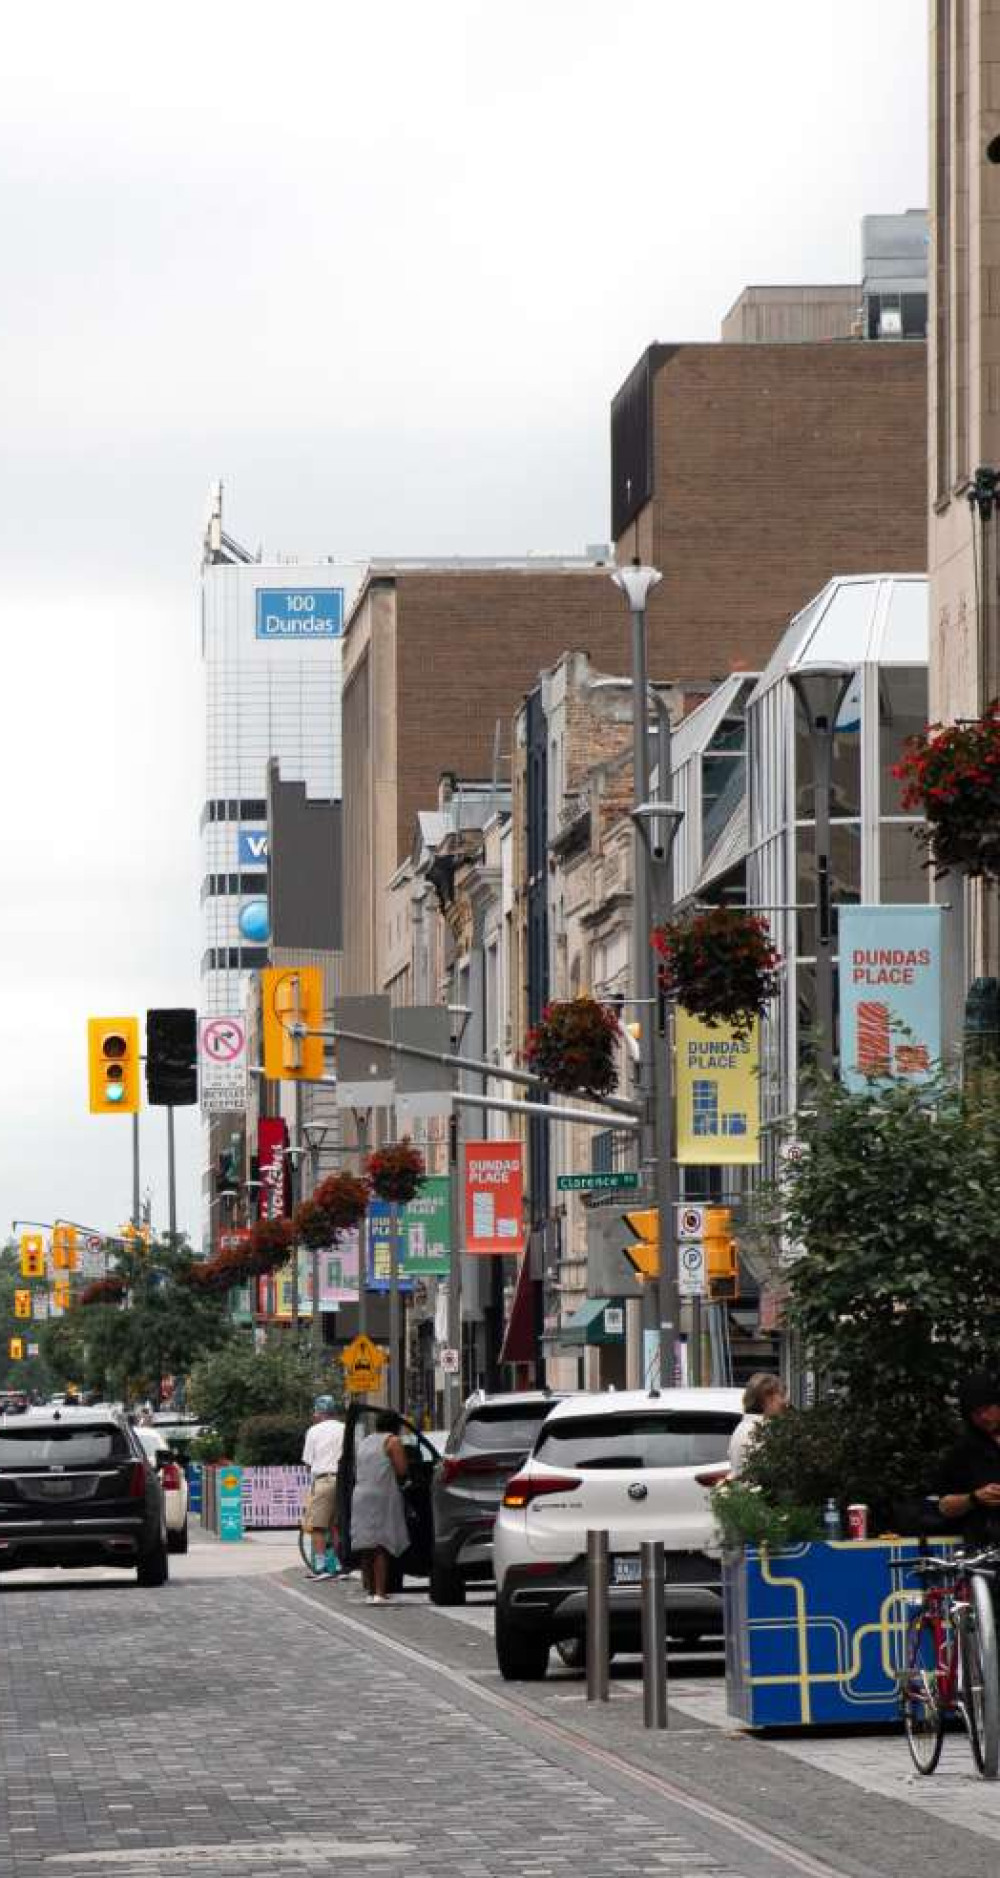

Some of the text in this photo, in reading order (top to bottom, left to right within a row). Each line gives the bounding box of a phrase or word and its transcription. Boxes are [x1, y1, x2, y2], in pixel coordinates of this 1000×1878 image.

[285, 595, 316, 612] 100
[266, 615, 333, 632] Dundas
[853, 949, 930, 966] DUNDAS
[853, 968, 914, 984] PLACE
[687, 1041, 751, 1055] DUNDAS
[687, 1056, 738, 1069] PLACE
[468, 1159, 519, 1171] DUNDAS
[468, 1172, 510, 1184] PLACE
[560, 1176, 619, 1190] Clarence
